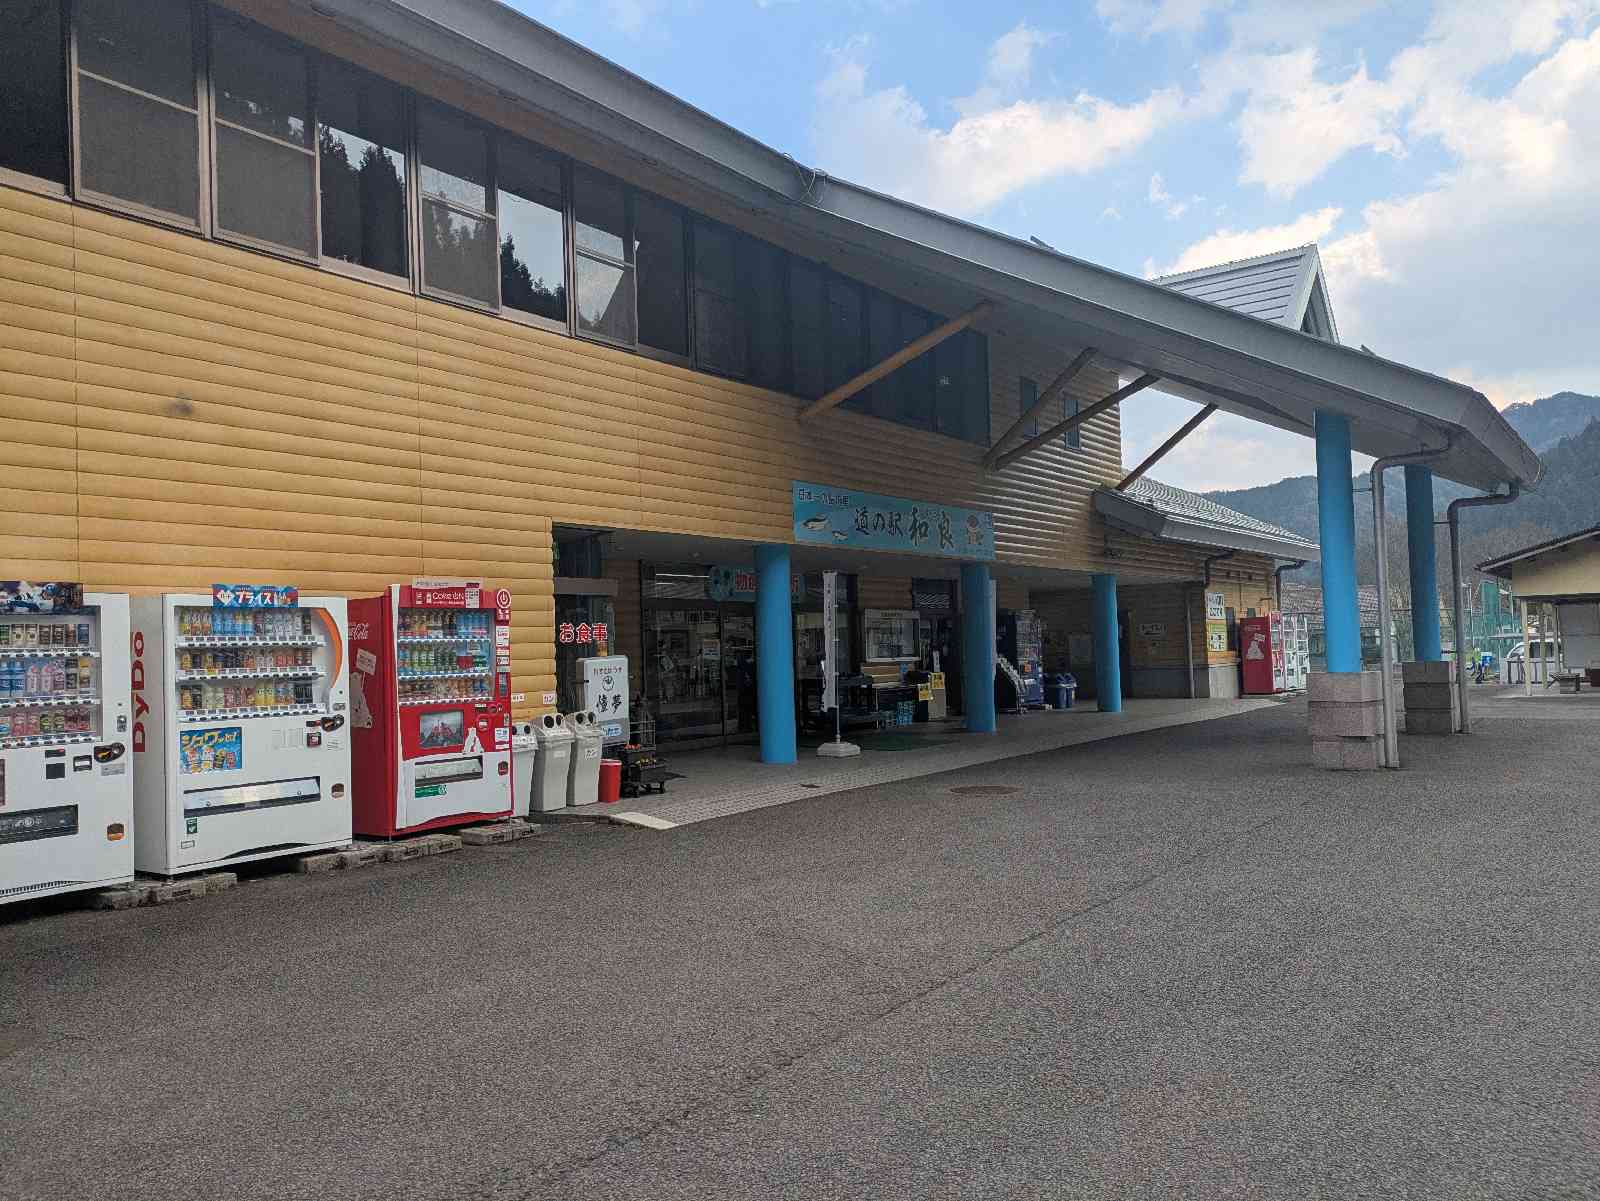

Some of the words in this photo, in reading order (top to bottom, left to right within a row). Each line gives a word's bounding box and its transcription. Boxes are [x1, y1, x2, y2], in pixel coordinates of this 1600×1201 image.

[559, 622, 608, 644] お食事
[131, 631, 149, 753] DyDo
